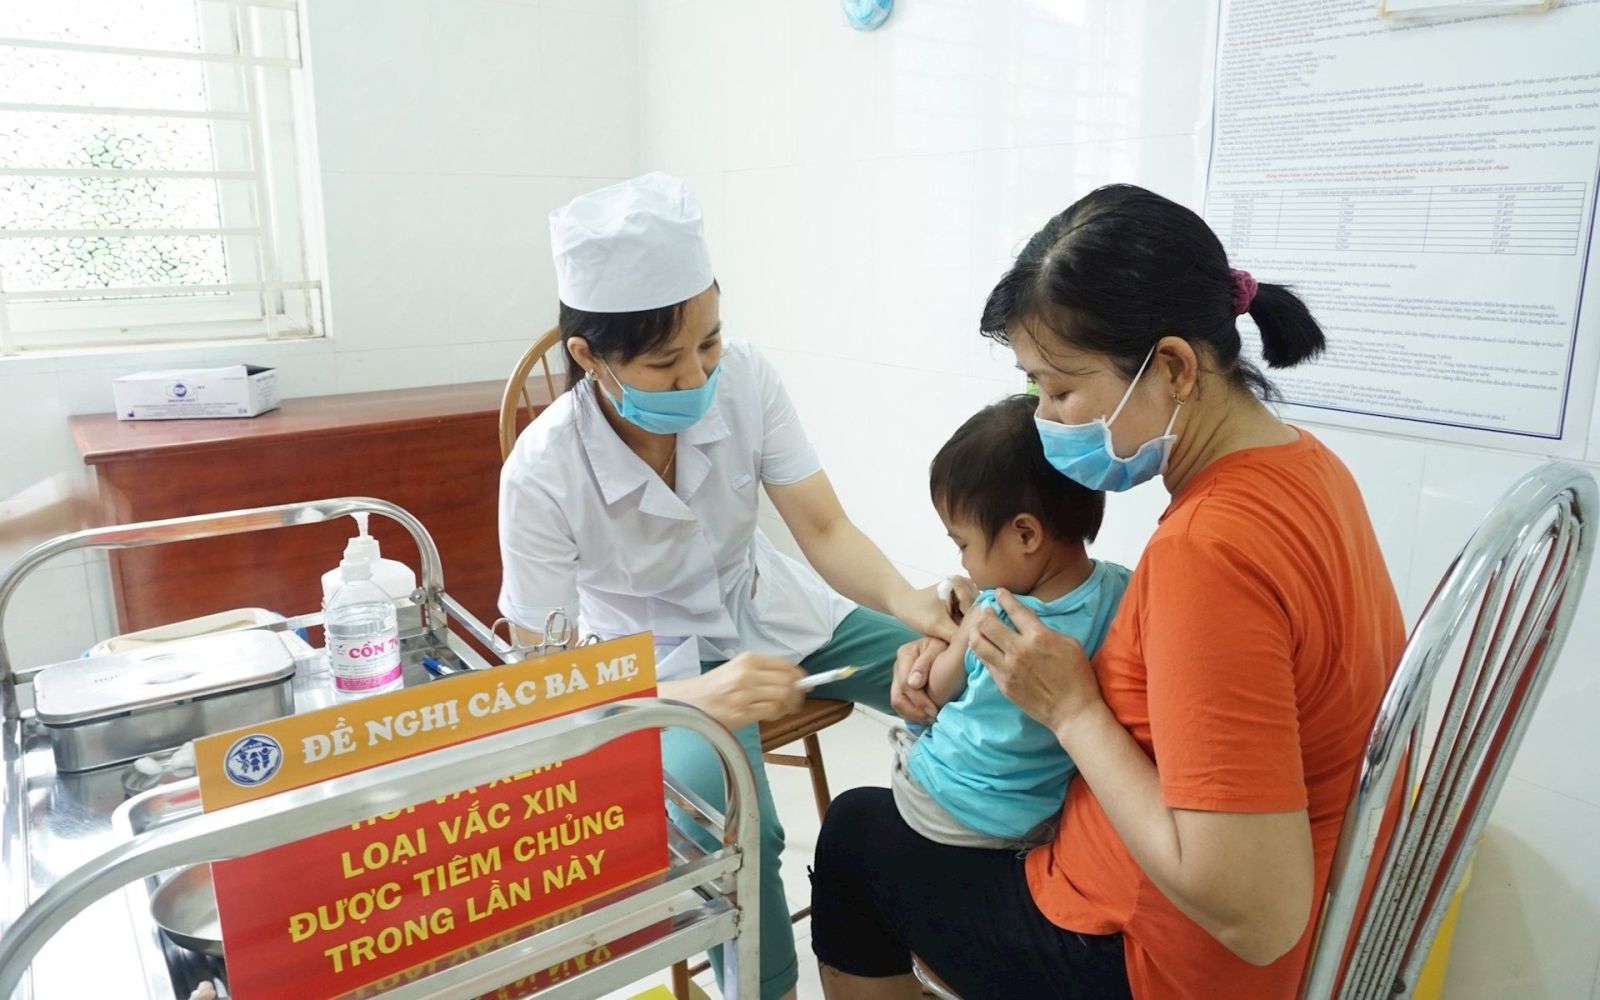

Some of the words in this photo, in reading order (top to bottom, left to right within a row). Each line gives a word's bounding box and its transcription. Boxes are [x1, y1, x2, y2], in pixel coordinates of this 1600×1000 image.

[349, 641, 385, 659] CỒN
[302, 717, 357, 764] ĐỀ
[365, 700, 460, 746] NGHỊ
[468, 682, 537, 718] CÁC
[544, 663, 589, 699] BÀ
[596, 653, 639, 685] MẸ
[288, 882, 402, 943] ĐƯỢC
[413, 846, 502, 897] TIÊM
[513, 805, 625, 863] CHỦNG
[341, 828, 428, 879] LOẠI
[438, 800, 512, 845] VẮC
[522, 779, 578, 820] XIN
[324, 907, 455, 973] TRONG
[466, 877, 531, 923] LẦN
[543, 849, 605, 894] NÀY
